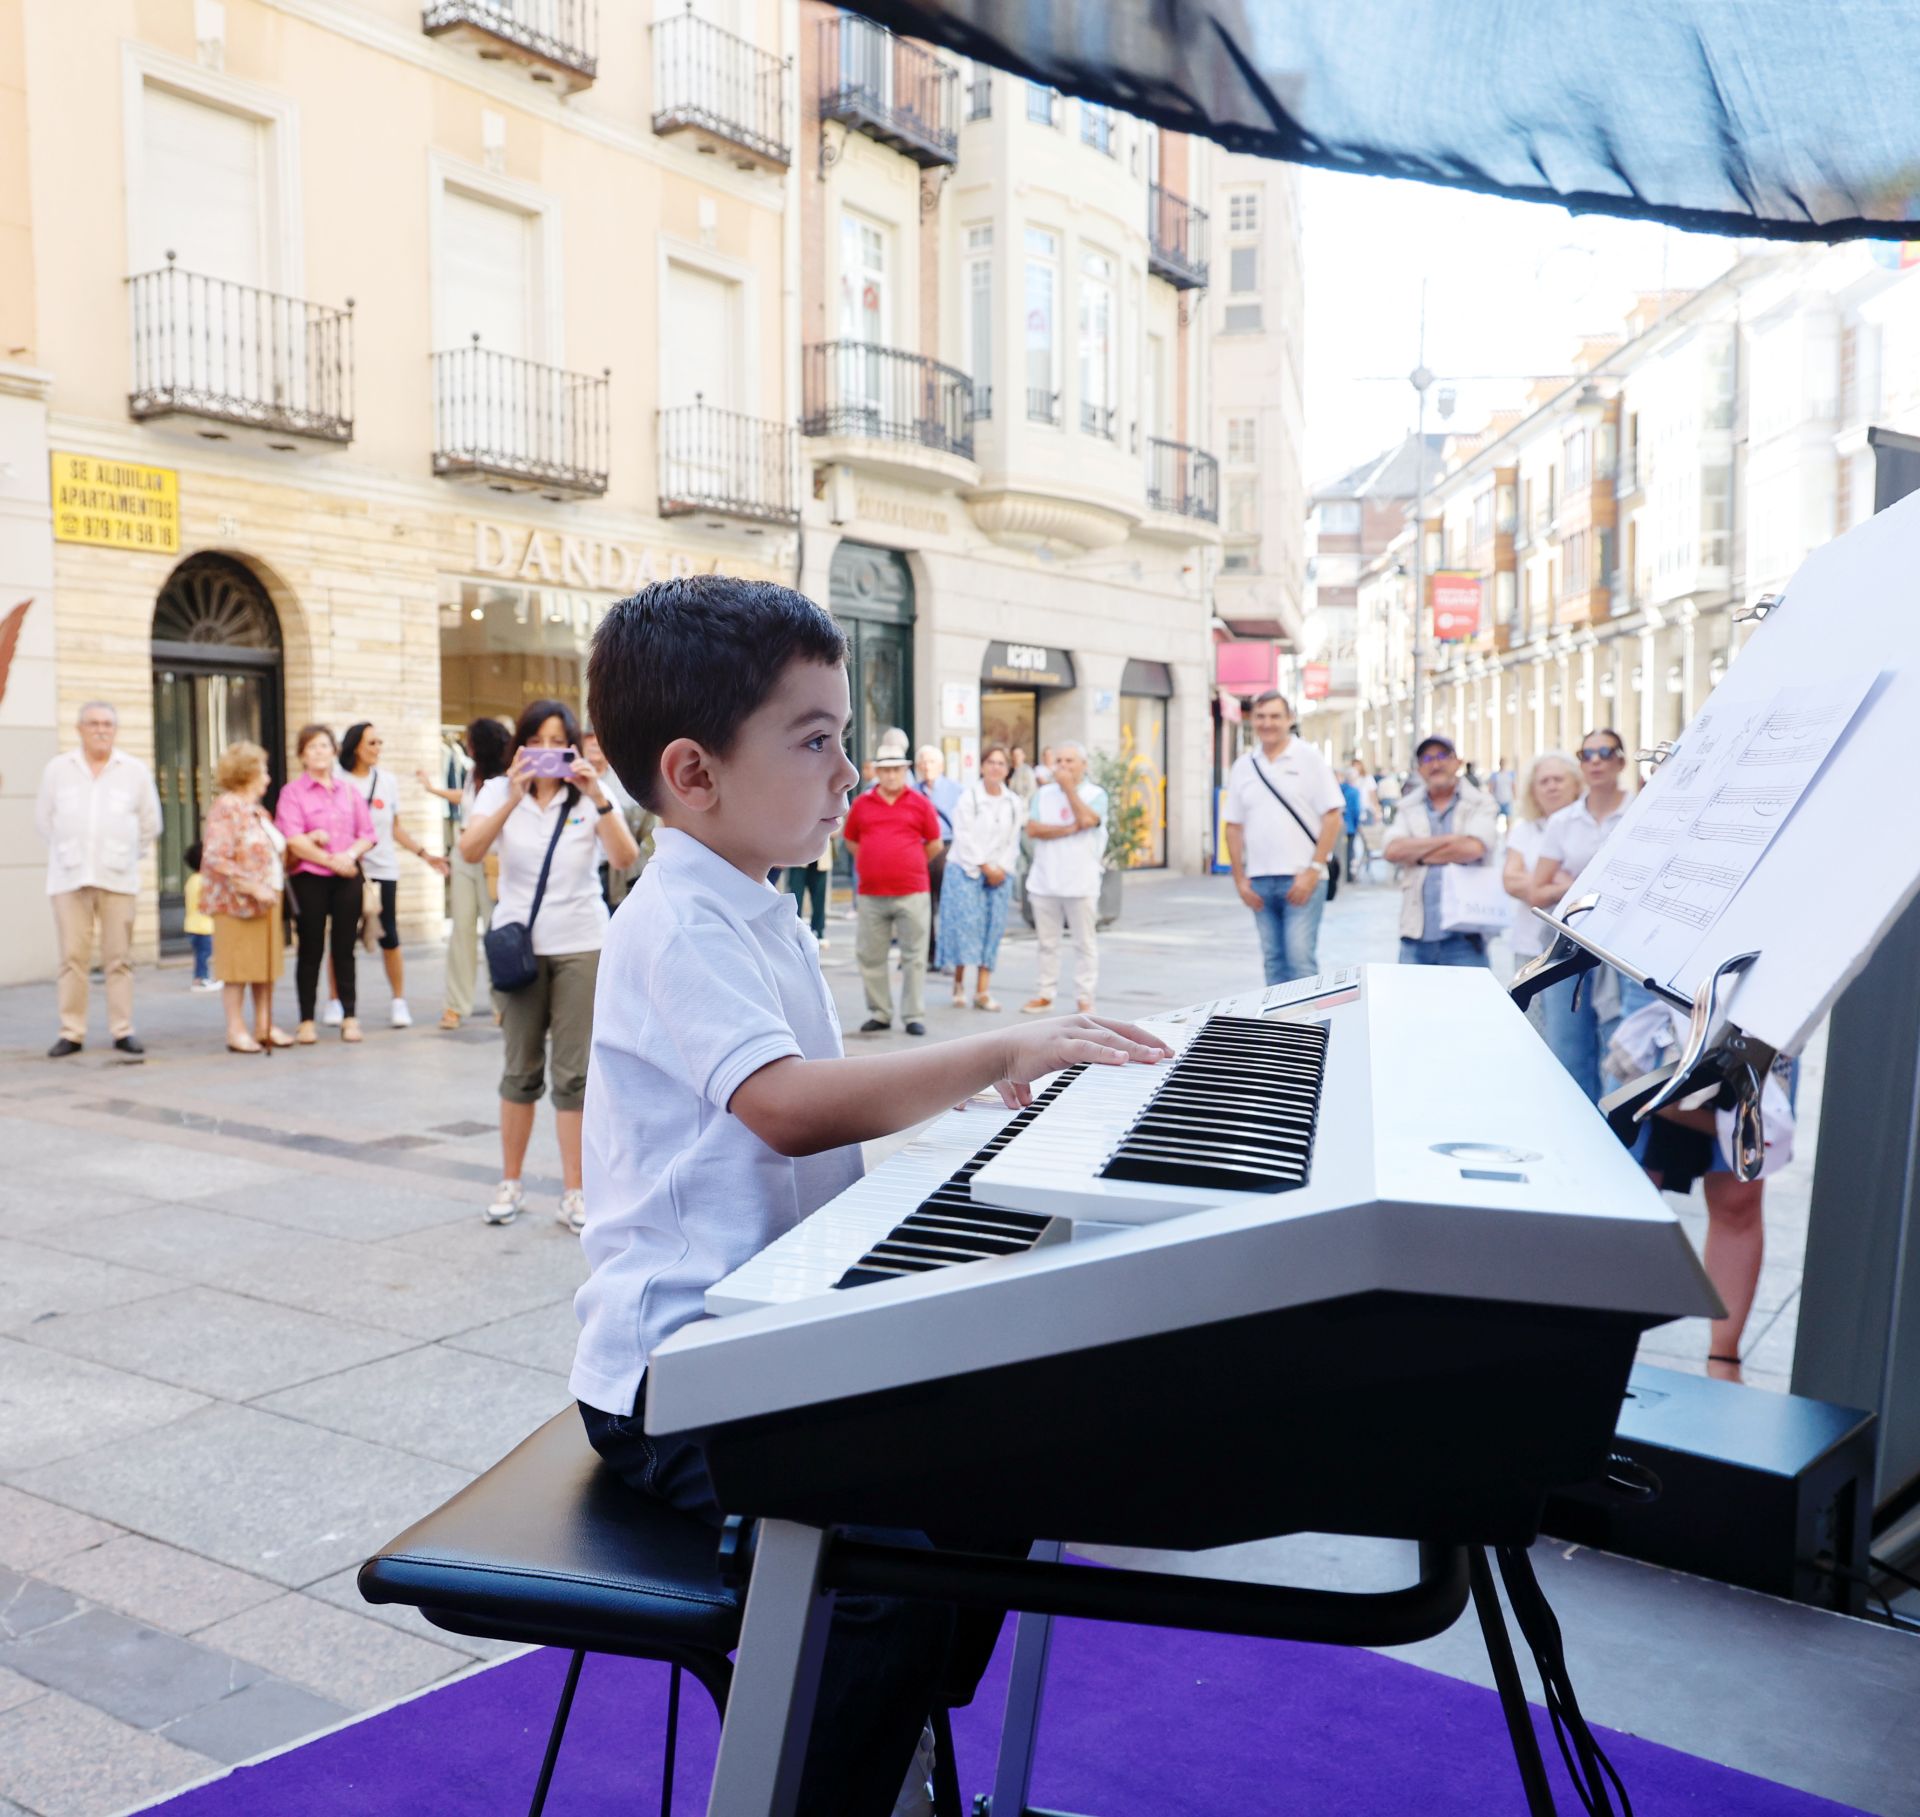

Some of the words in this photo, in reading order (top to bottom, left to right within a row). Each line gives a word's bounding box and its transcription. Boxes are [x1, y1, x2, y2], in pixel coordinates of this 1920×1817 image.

[70, 459, 88, 482] SE
[95, 465, 163, 492] ALQUILAN
[59, 486, 173, 520] APARTAMENTOS
